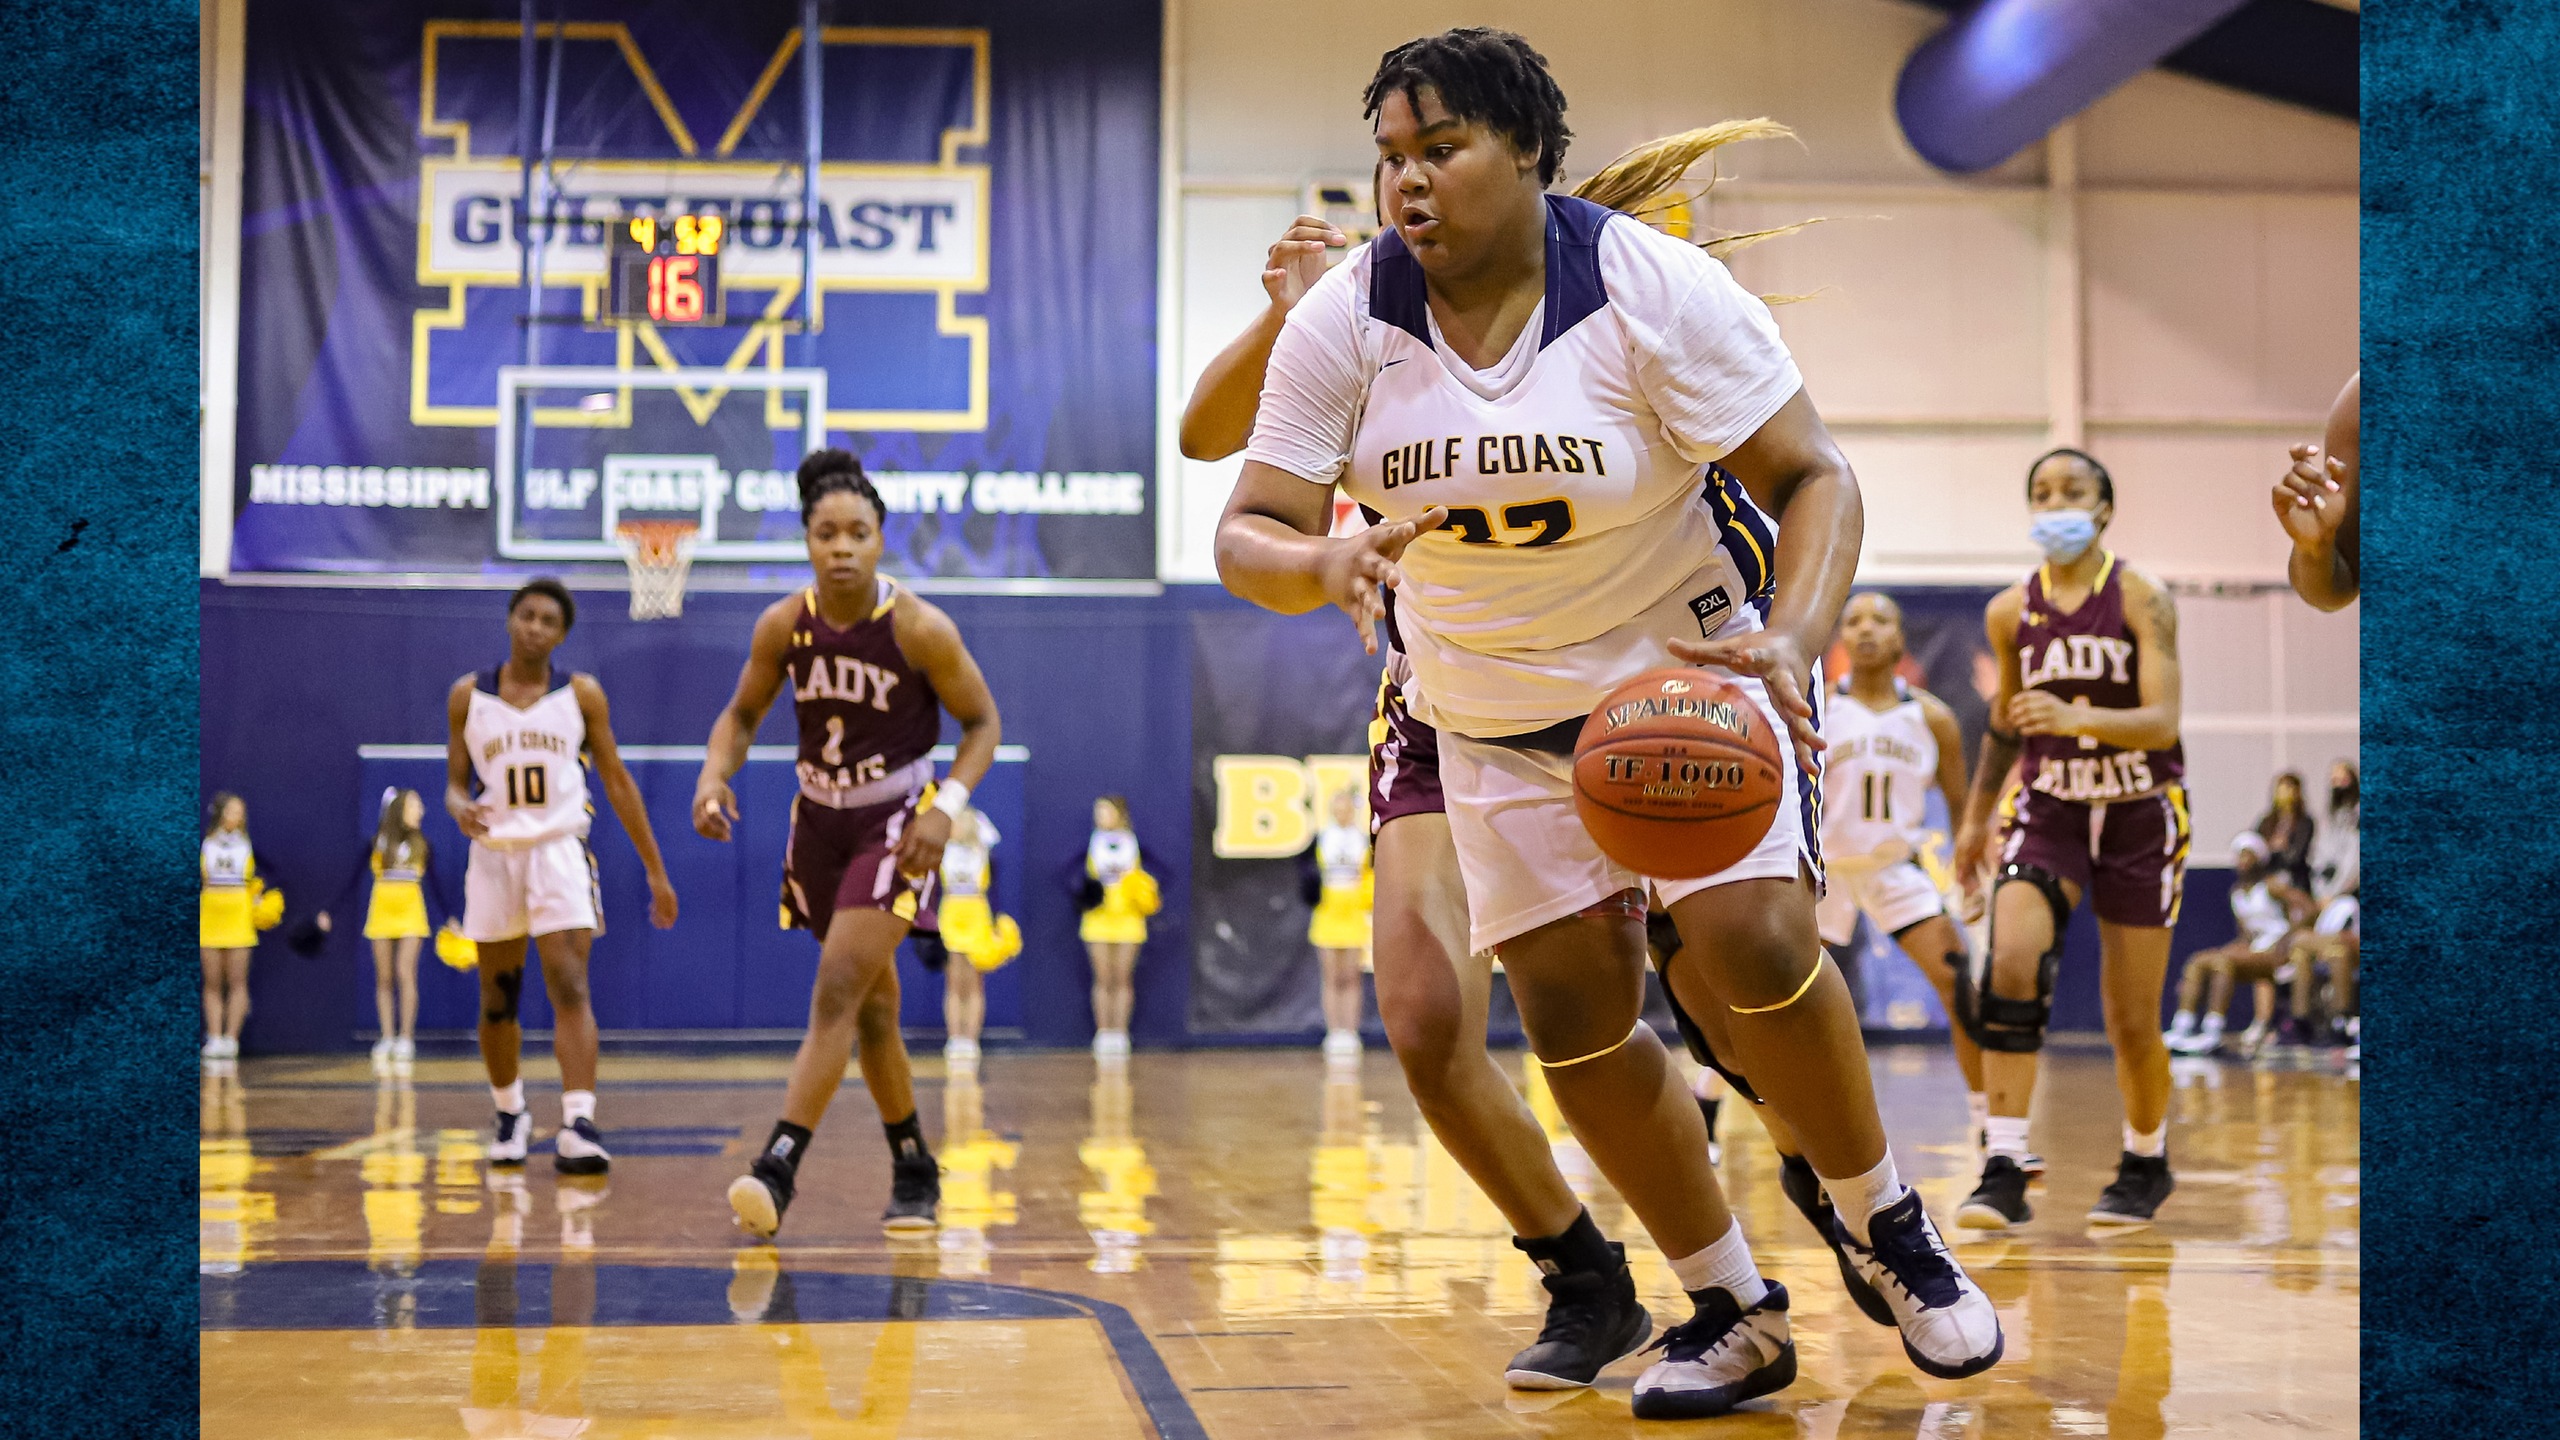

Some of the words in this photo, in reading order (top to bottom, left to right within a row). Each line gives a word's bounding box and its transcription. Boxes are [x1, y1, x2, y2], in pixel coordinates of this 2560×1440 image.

[685, 197, 954, 253] OAST
[647, 256, 704, 321] 16
[1382, 436, 1463, 490] GULF
[1478, 433, 1607, 477] COAST
[250, 464, 491, 509] MISSISSIPPI
[525, 469, 598, 511] ULF
[972, 471, 1145, 515] COLLEGE
[1697, 593, 1726, 614] 2XL
[786, 655, 899, 712] LADY
[2019, 634, 2132, 690] LADY
[1604, 697, 1750, 741] SPALDING
[504, 763, 549, 810] 10
[1863, 771, 1893, 823] 11
